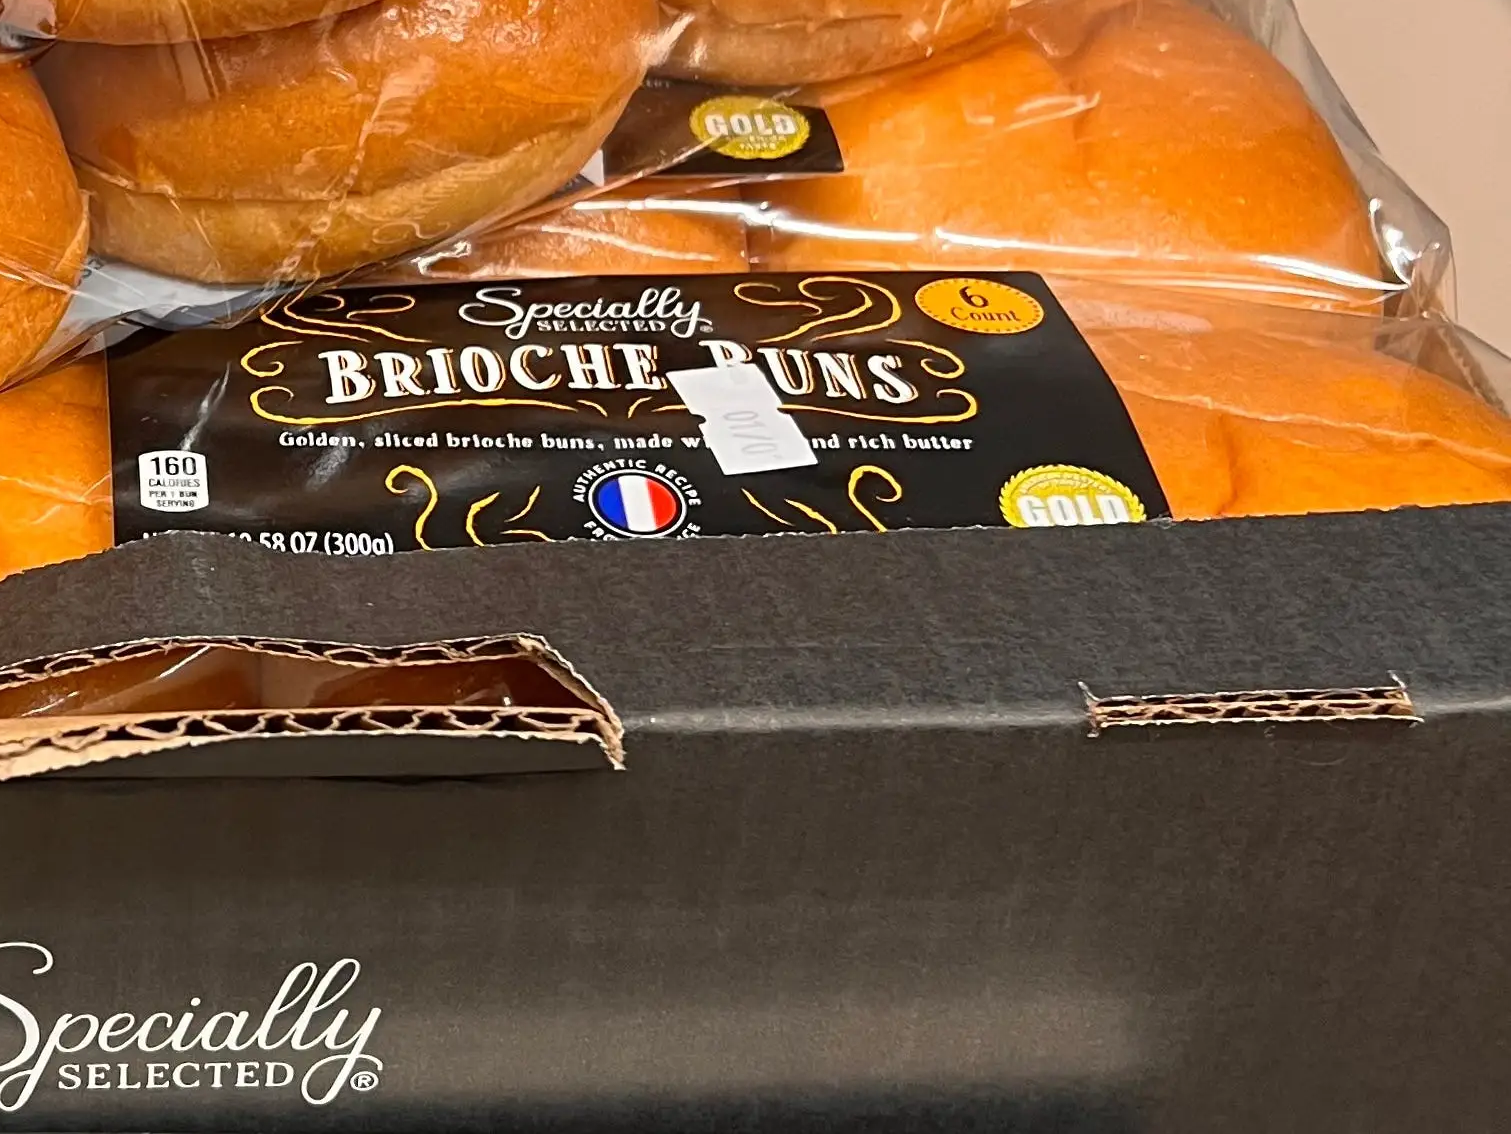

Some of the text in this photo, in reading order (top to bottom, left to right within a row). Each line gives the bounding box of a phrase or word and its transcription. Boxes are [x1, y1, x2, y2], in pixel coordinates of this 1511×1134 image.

[704, 112, 798, 137] GOLD
[959, 286, 990, 308] 6
[458, 286, 713, 340] Specially
[950, 306, 1021, 321] Count
[536, 319, 667, 332] SELECTED
[318, 341, 669, 405] BRIOCHE
[278, 431, 366, 449] Golden,
[374, 432, 439, 447] sliced
[446, 432, 533, 448] brioche
[541, 432, 605, 452] buns,
[614, 434, 673, 449] made
[722, 410, 783, 459] 01/0
[810, 433, 974, 451] nd rich butter
[150, 456, 197, 476] 160
[148, 478, 201, 488] CALORIES
[572, 459, 702, 506] AUTHENTIC RECIPE
[149, 490, 167, 498] PER
[179, 490, 198, 498] BUN
[156, 499, 195, 507] SERVING
[1016, 494, 1131, 528] GOLD
[290, 531, 319, 553] OZ
[57, 1061, 294, 1090] SELECTED
